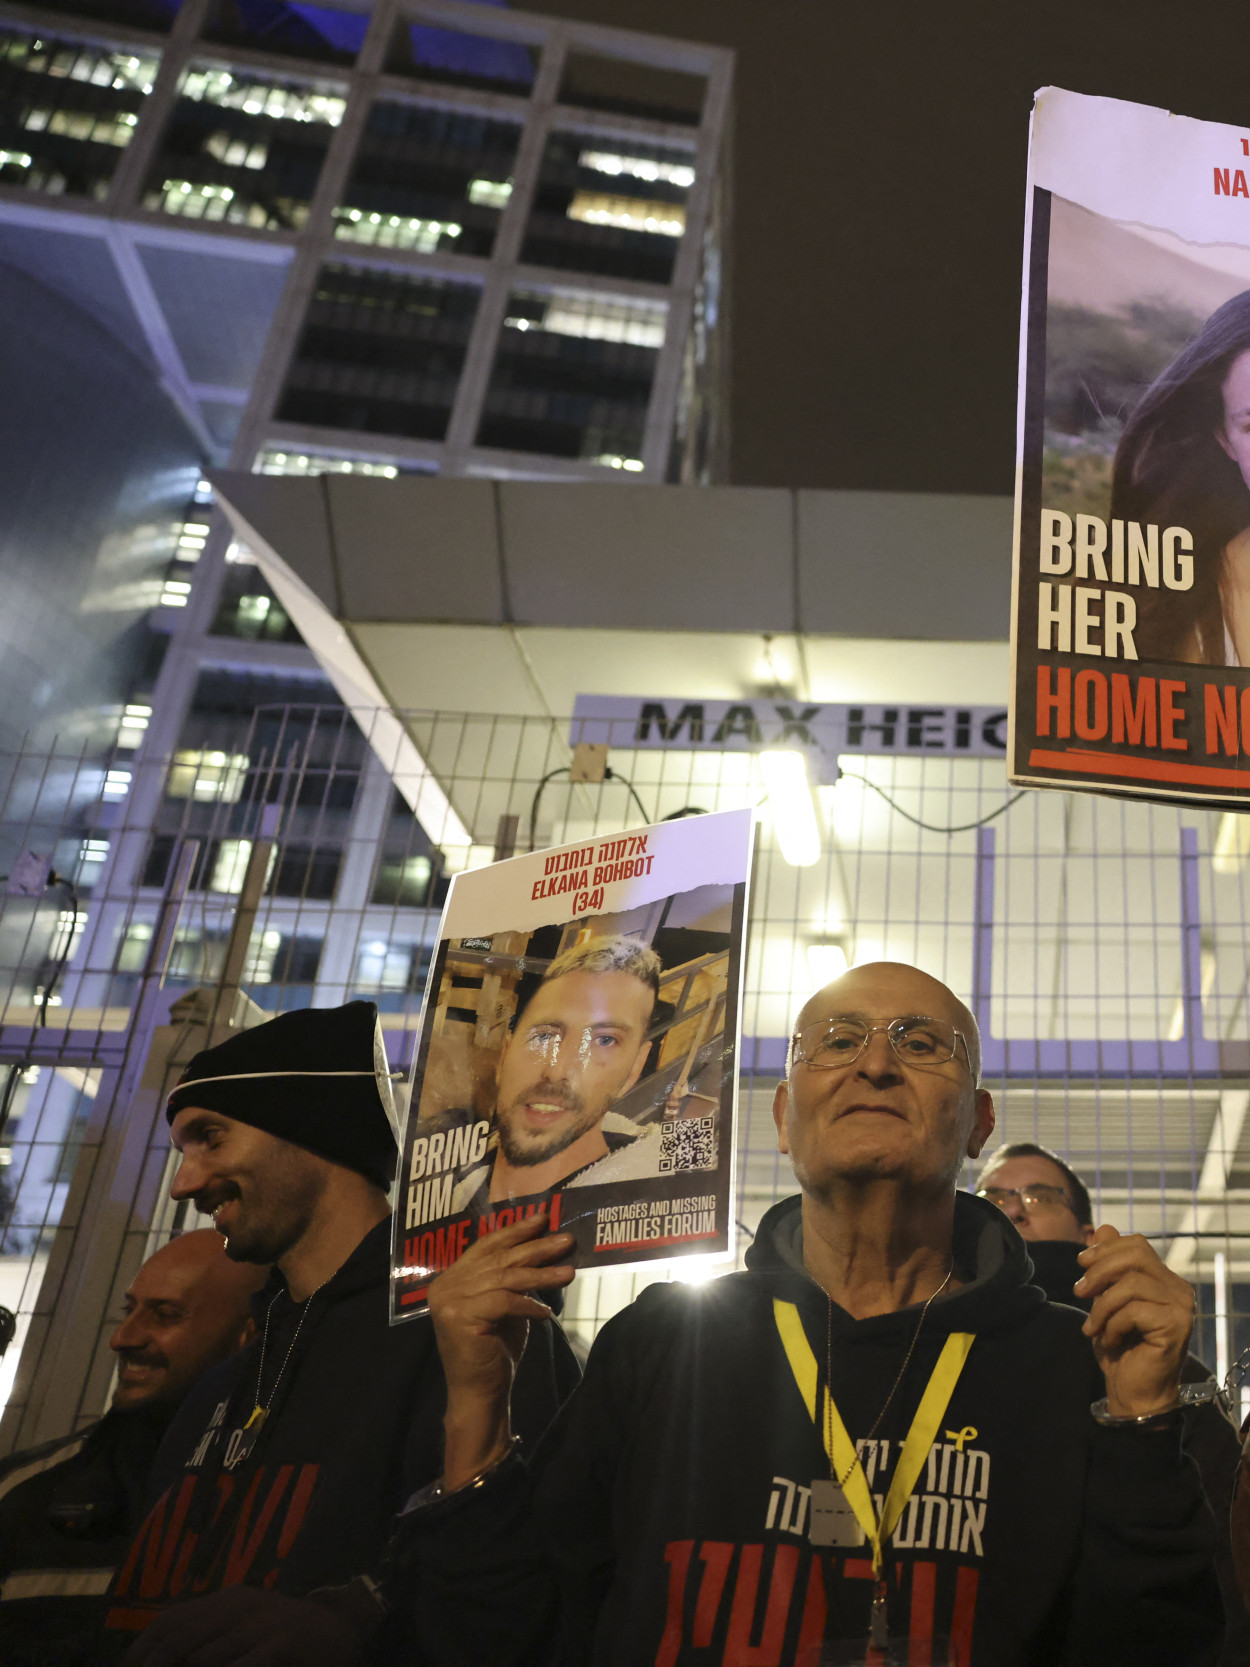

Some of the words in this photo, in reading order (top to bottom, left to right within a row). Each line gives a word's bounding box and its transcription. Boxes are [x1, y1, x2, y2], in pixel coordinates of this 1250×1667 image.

[1039, 508, 1195, 592] BRING
[1037, 581, 1139, 661] HER
[637, 703, 821, 748] MAX
[1035, 665, 1189, 752] HOME
[544, 847, 594, 875] בוחבוט
[598, 835, 648, 864] אלקנה
[531, 870, 588, 901] ELKANA
[592, 855, 655, 885] BOHBOT
[572, 887, 604, 915] (34)
[410, 1120, 490, 1182] BRING
[405, 1181, 454, 1230] HIM
[595, 1217, 662, 1246] FAMILIES
[664, 1210, 716, 1237] FORUM
[596, 1202, 648, 1223] HOSTAGES
[649, 1199, 670, 1217] AND
[671, 1194, 716, 1213] MISSING
